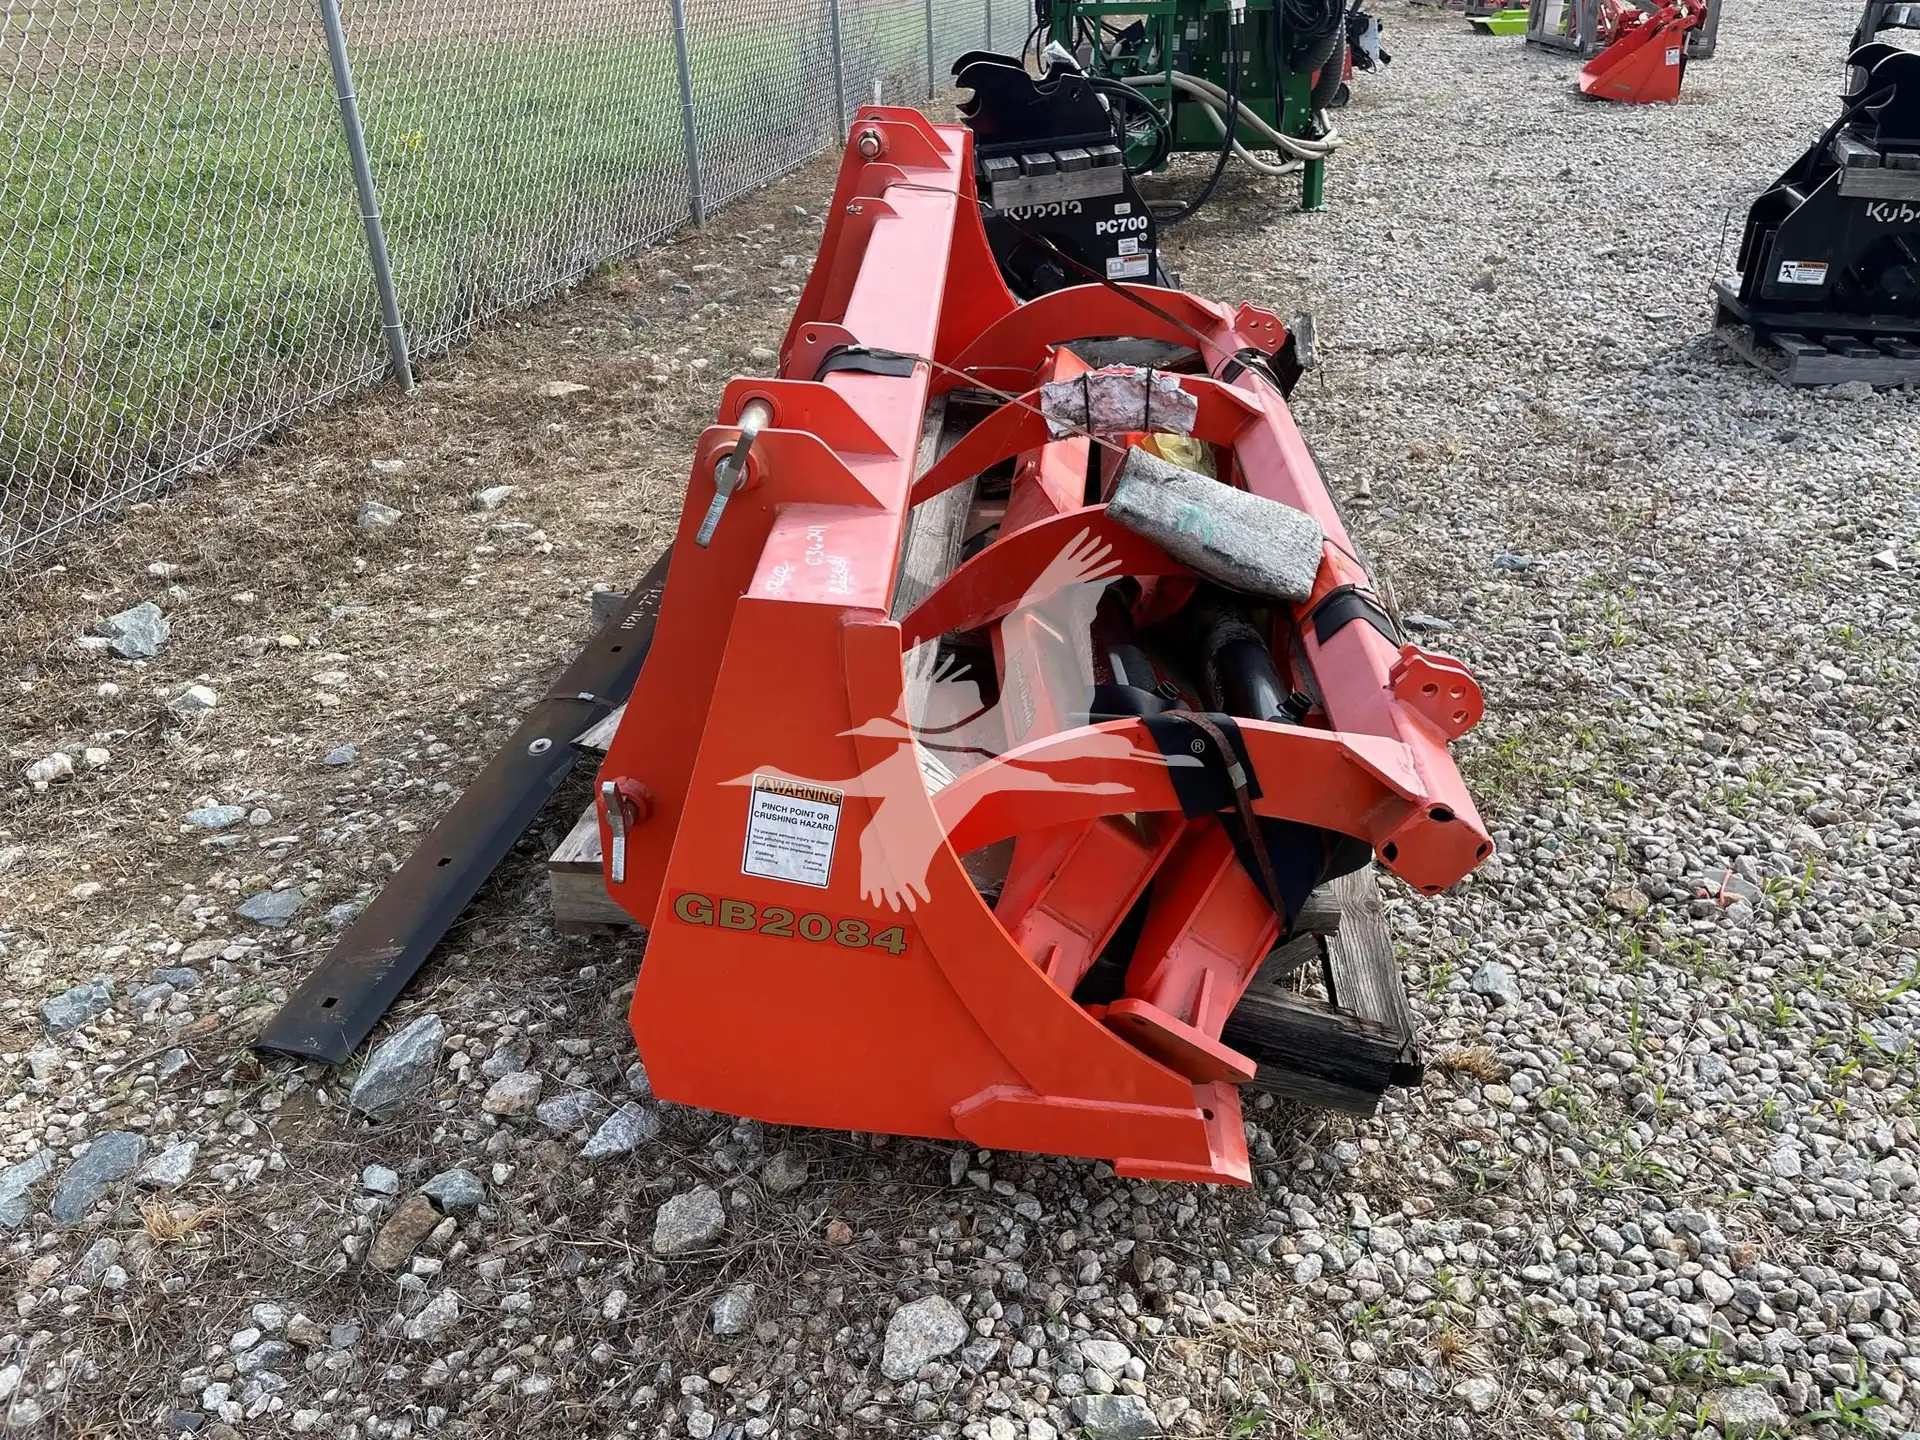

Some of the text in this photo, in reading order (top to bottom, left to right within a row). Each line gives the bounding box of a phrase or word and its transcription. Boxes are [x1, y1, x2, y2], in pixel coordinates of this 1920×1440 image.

[1095, 215, 1148, 235] PC700
[772, 779, 841, 805] WARNING
[753, 810, 835, 832] CRUSHING HAZARD
[761, 802, 830, 821] PINCH POINT OR
[673, 892, 907, 955] GB2084
